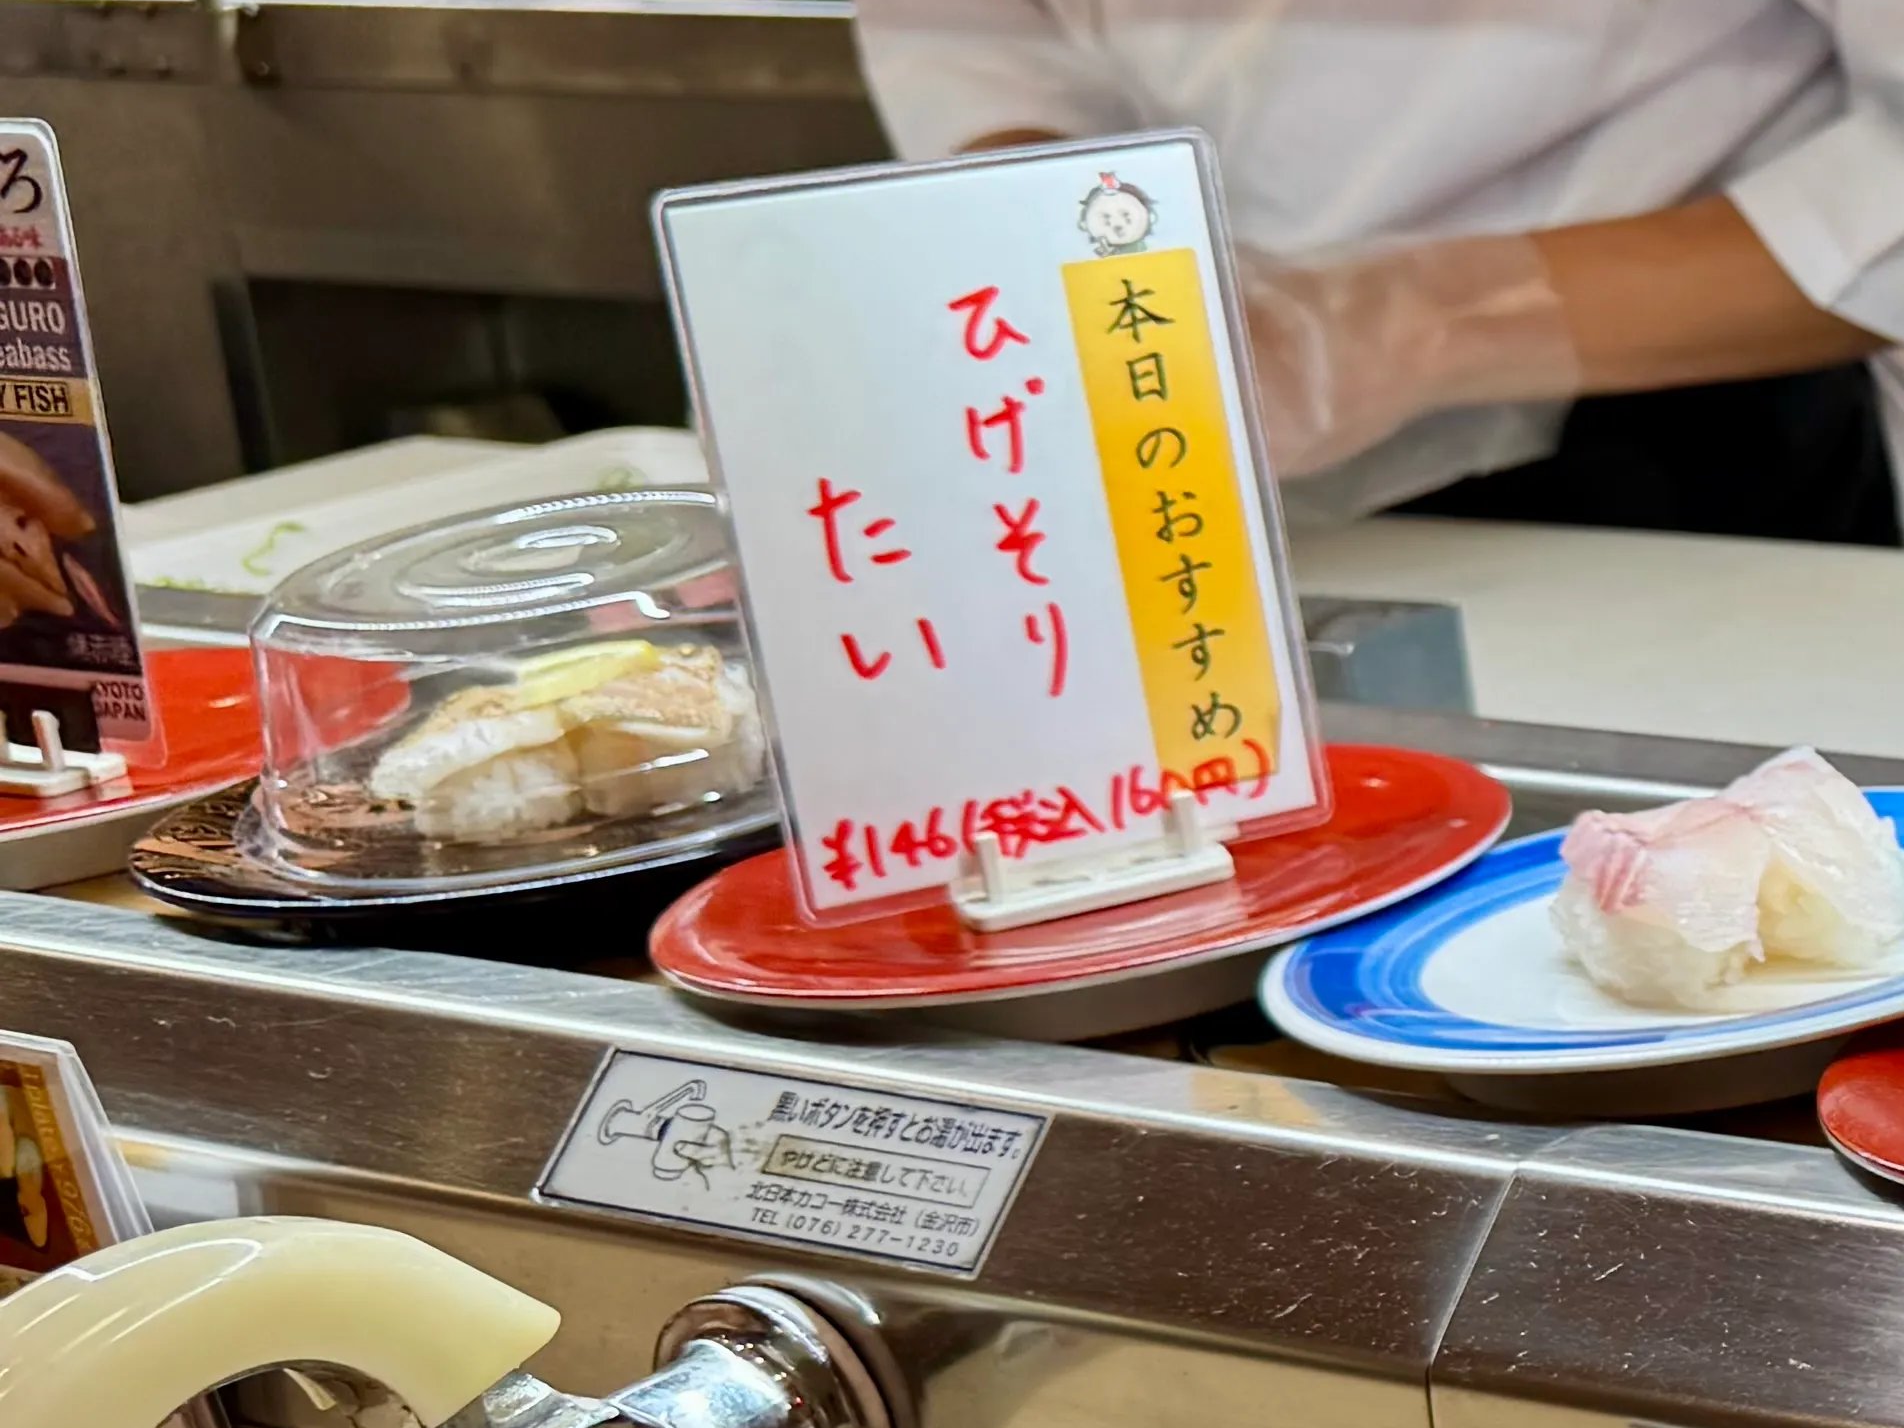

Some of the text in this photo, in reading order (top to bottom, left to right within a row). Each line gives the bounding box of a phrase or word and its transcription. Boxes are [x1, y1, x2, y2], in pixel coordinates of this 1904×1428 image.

[15, 385, 68, 413] FISH
[948, 284, 1070, 699] ひげそり
[1106, 279, 1242, 740] 本日のおすすめ
[807, 477, 947, 682] たい
[766, 1090, 1024, 1159] 黒いボタンを押すとお湯が出ます。
[751, 1206, 780, 1227] TEL
[847, 1224, 959, 1257] 277-1230
